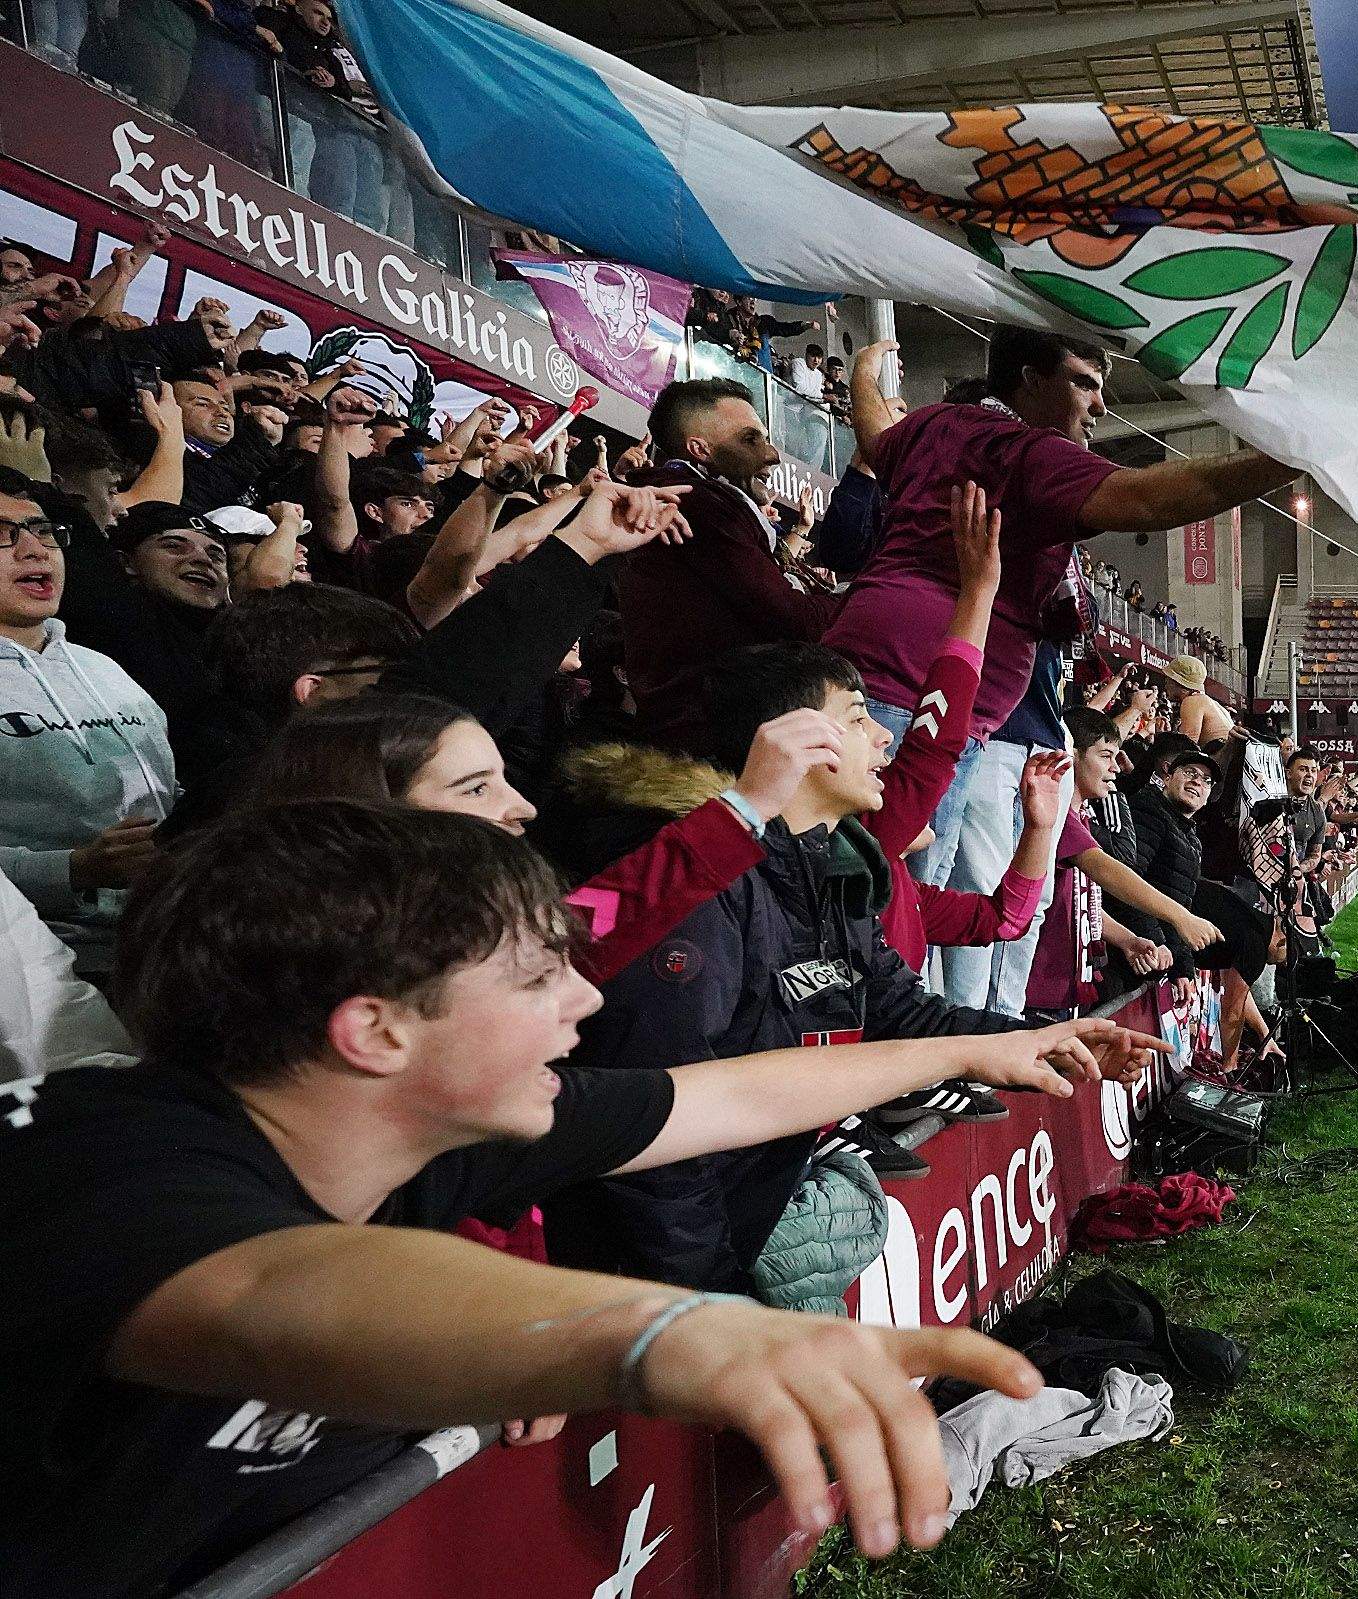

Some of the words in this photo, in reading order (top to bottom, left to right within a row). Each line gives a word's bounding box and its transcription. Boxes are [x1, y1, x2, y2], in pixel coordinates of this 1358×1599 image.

[109, 121, 369, 304] Estrella
[378, 254, 538, 382] Galicia
[932, 1129, 1057, 1324] ence
[1004, 1291, 1013, 1314] &
